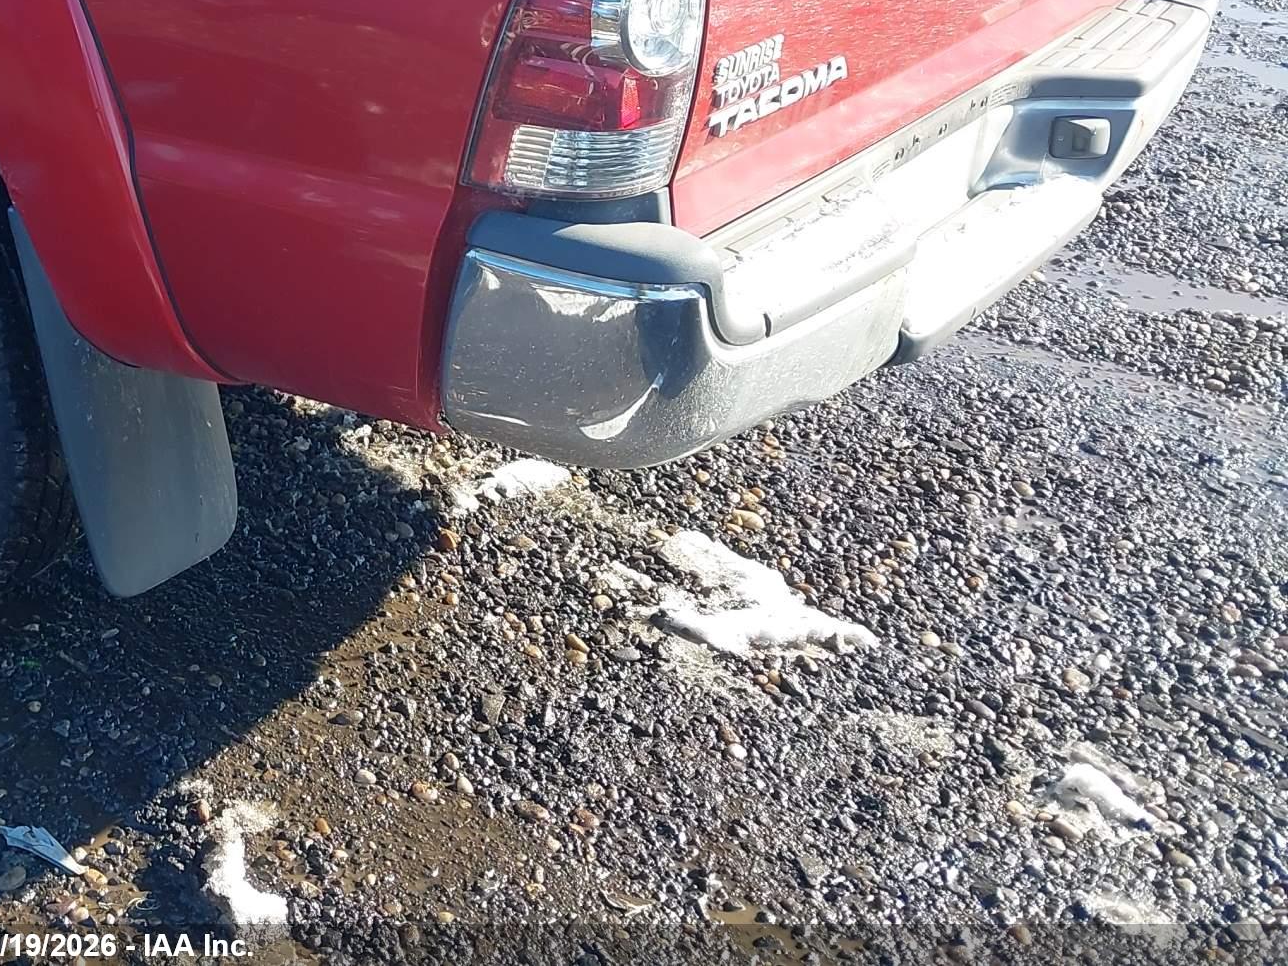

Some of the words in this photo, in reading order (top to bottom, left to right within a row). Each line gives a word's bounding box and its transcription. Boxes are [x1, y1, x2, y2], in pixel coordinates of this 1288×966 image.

[713, 33, 785, 85] SUNRISE
[713, 61, 781, 109] TOYOTA
[708, 54, 848, 138] TACOMA
